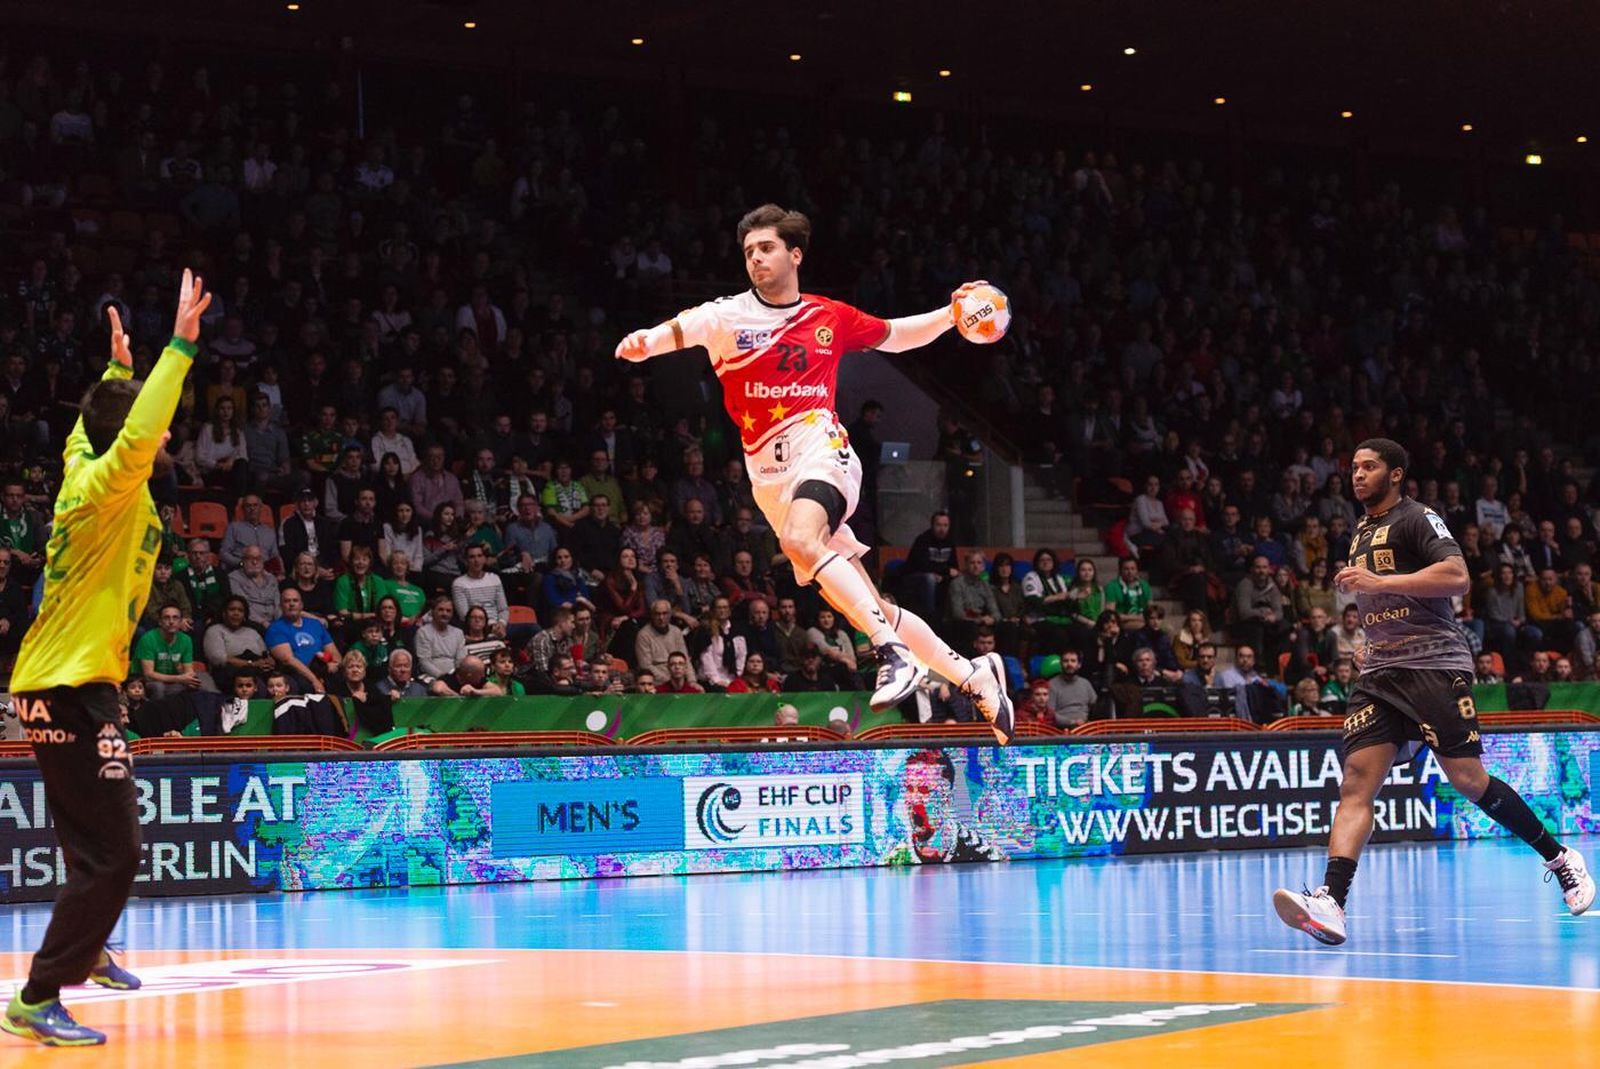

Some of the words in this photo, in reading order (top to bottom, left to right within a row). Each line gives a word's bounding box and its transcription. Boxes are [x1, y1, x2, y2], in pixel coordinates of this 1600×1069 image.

[963, 304, 993, 328] SELECT
[777, 342, 808, 371] 23
[744, 380, 829, 399] Liberbank
[1365, 607, 1410, 625] Océan
[1458, 697, 1476, 719] 8
[97, 739, 127, 758] 92
[1016, 752, 1198, 798] TICKETS
[1206, 748, 1414, 792] AVAILAE
[232, 775, 306, 822] AT
[759, 785, 799, 806] EHF
[805, 784, 852, 805] CUP
[538, 800, 640, 834] MEN'S
[758, 814, 854, 836] FINALS
